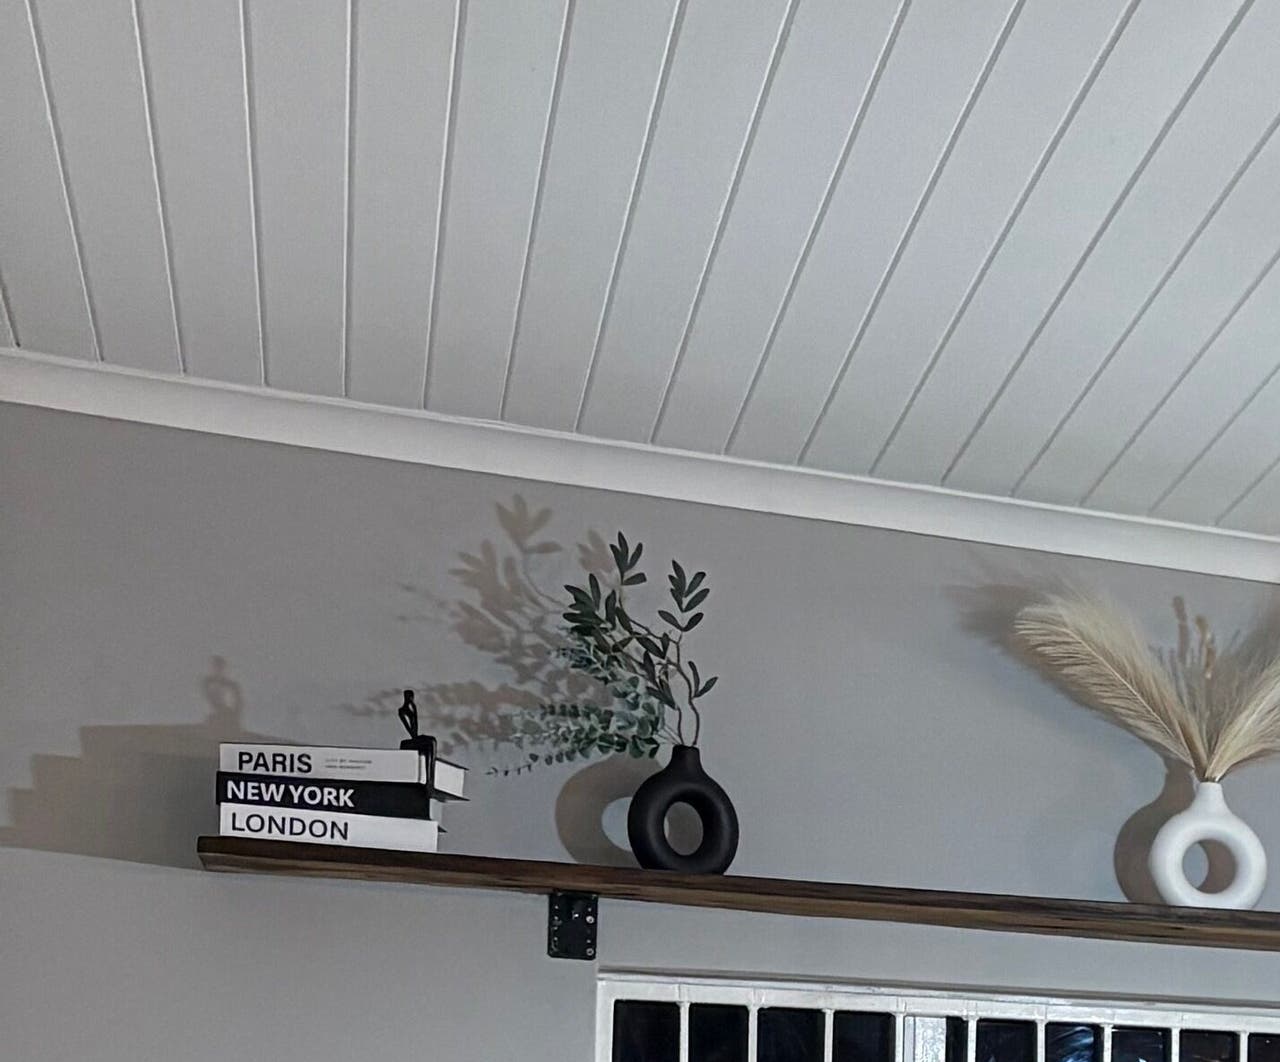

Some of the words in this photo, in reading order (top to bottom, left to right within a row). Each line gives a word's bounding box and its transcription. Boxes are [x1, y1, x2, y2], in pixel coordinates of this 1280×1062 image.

[238, 751, 313, 774] PARIS
[226, 780, 285, 802] NEW
[289, 784, 355, 808] YORK
[231, 811, 349, 841] LONDON
